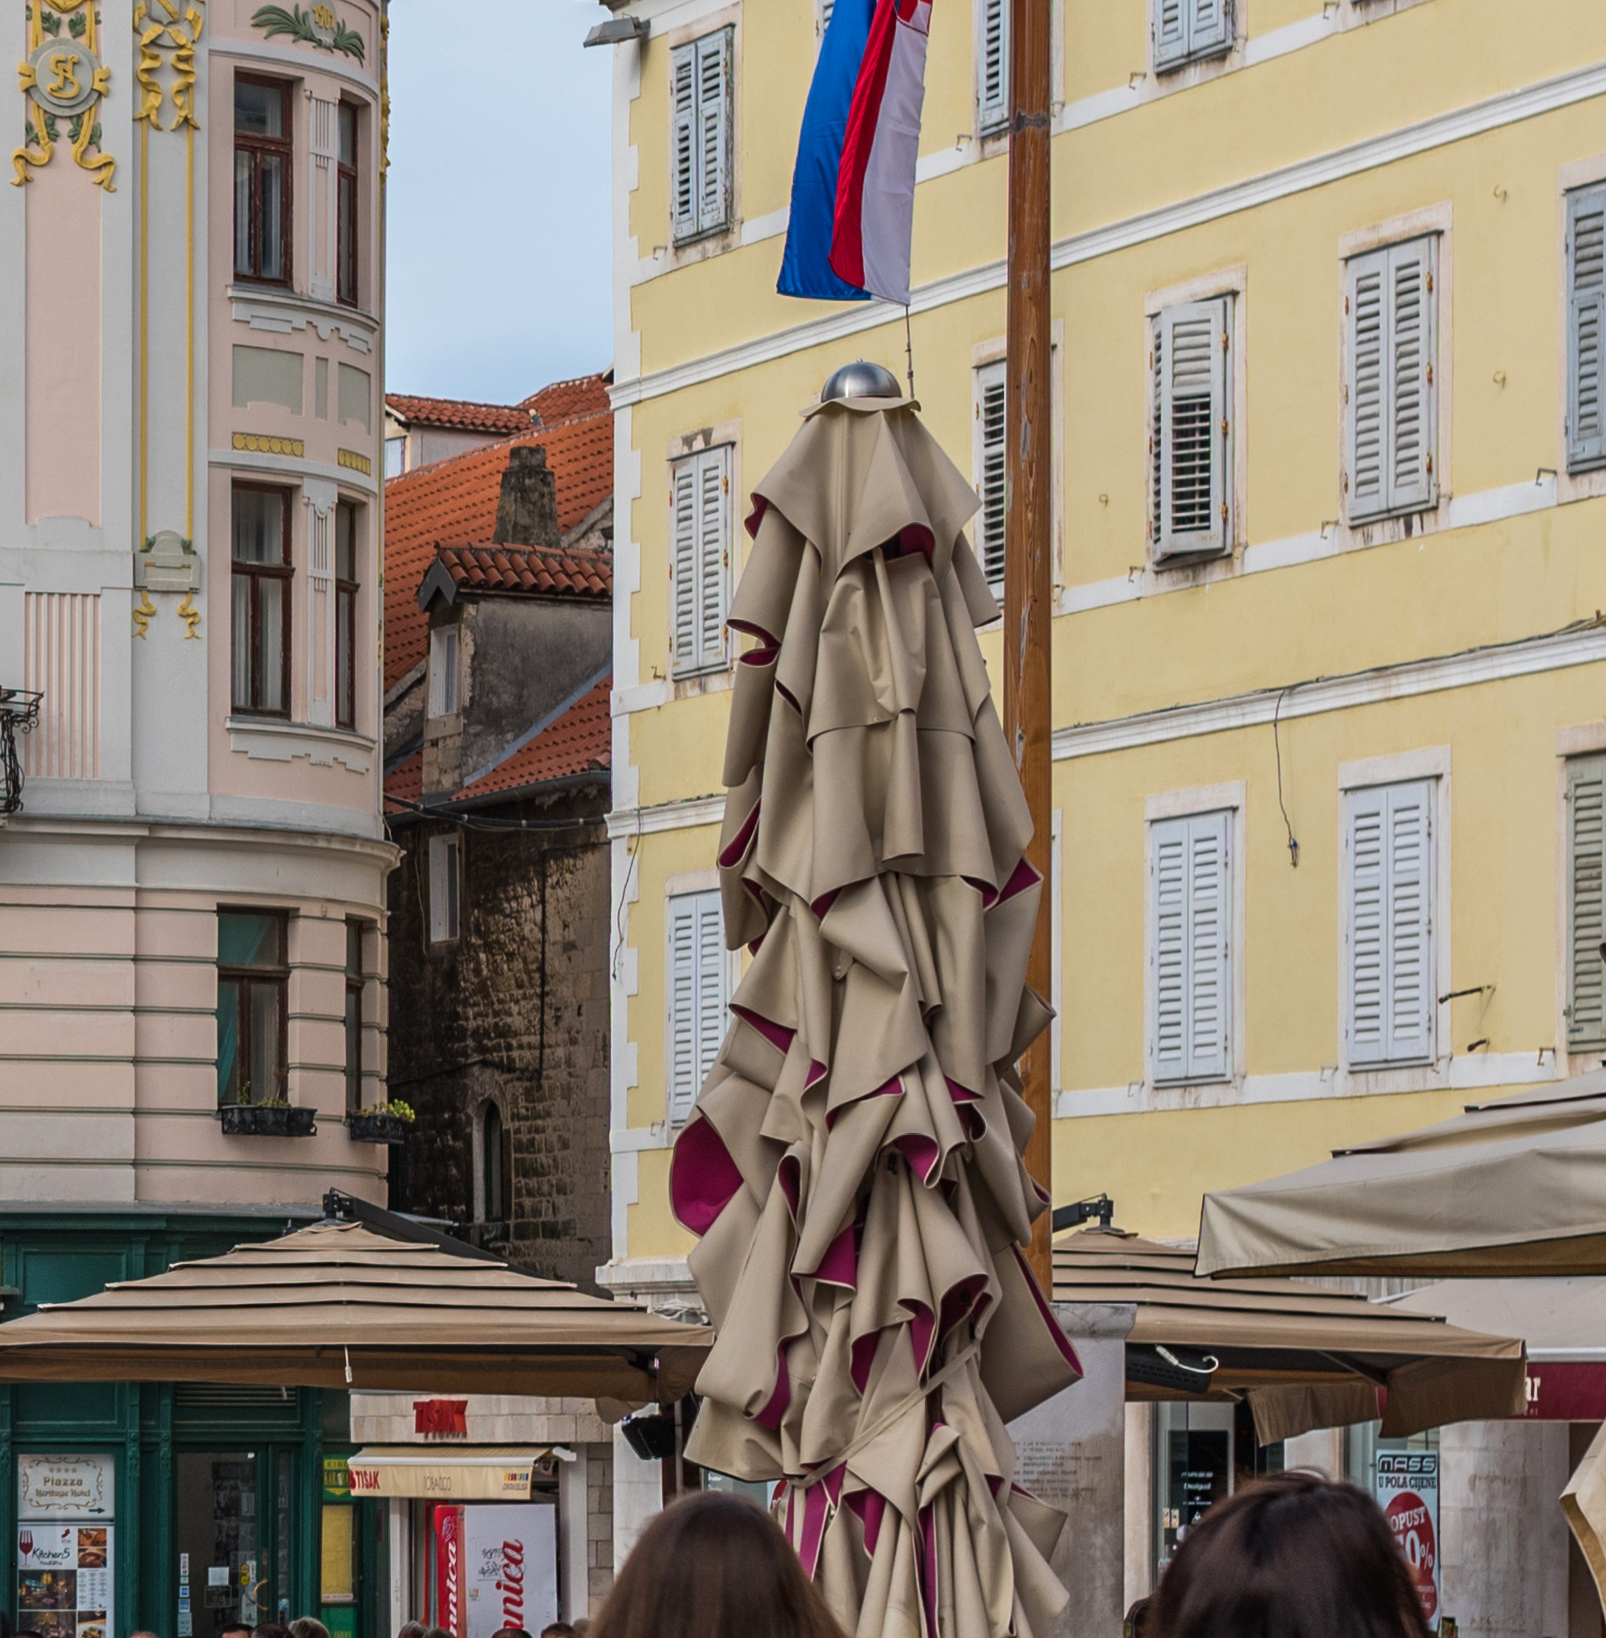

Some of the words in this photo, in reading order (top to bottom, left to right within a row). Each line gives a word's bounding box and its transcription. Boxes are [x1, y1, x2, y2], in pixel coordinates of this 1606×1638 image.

[413, 1399, 468, 1434] TISAK
[1379, 1456, 1436, 1472] MASS
[43, 1476, 83, 1486] Piazza
[355, 1470, 380, 1490] TISAK
[1386, 1476, 1408, 1488] POLA
[1391, 1506, 1426, 1531] OPUST
